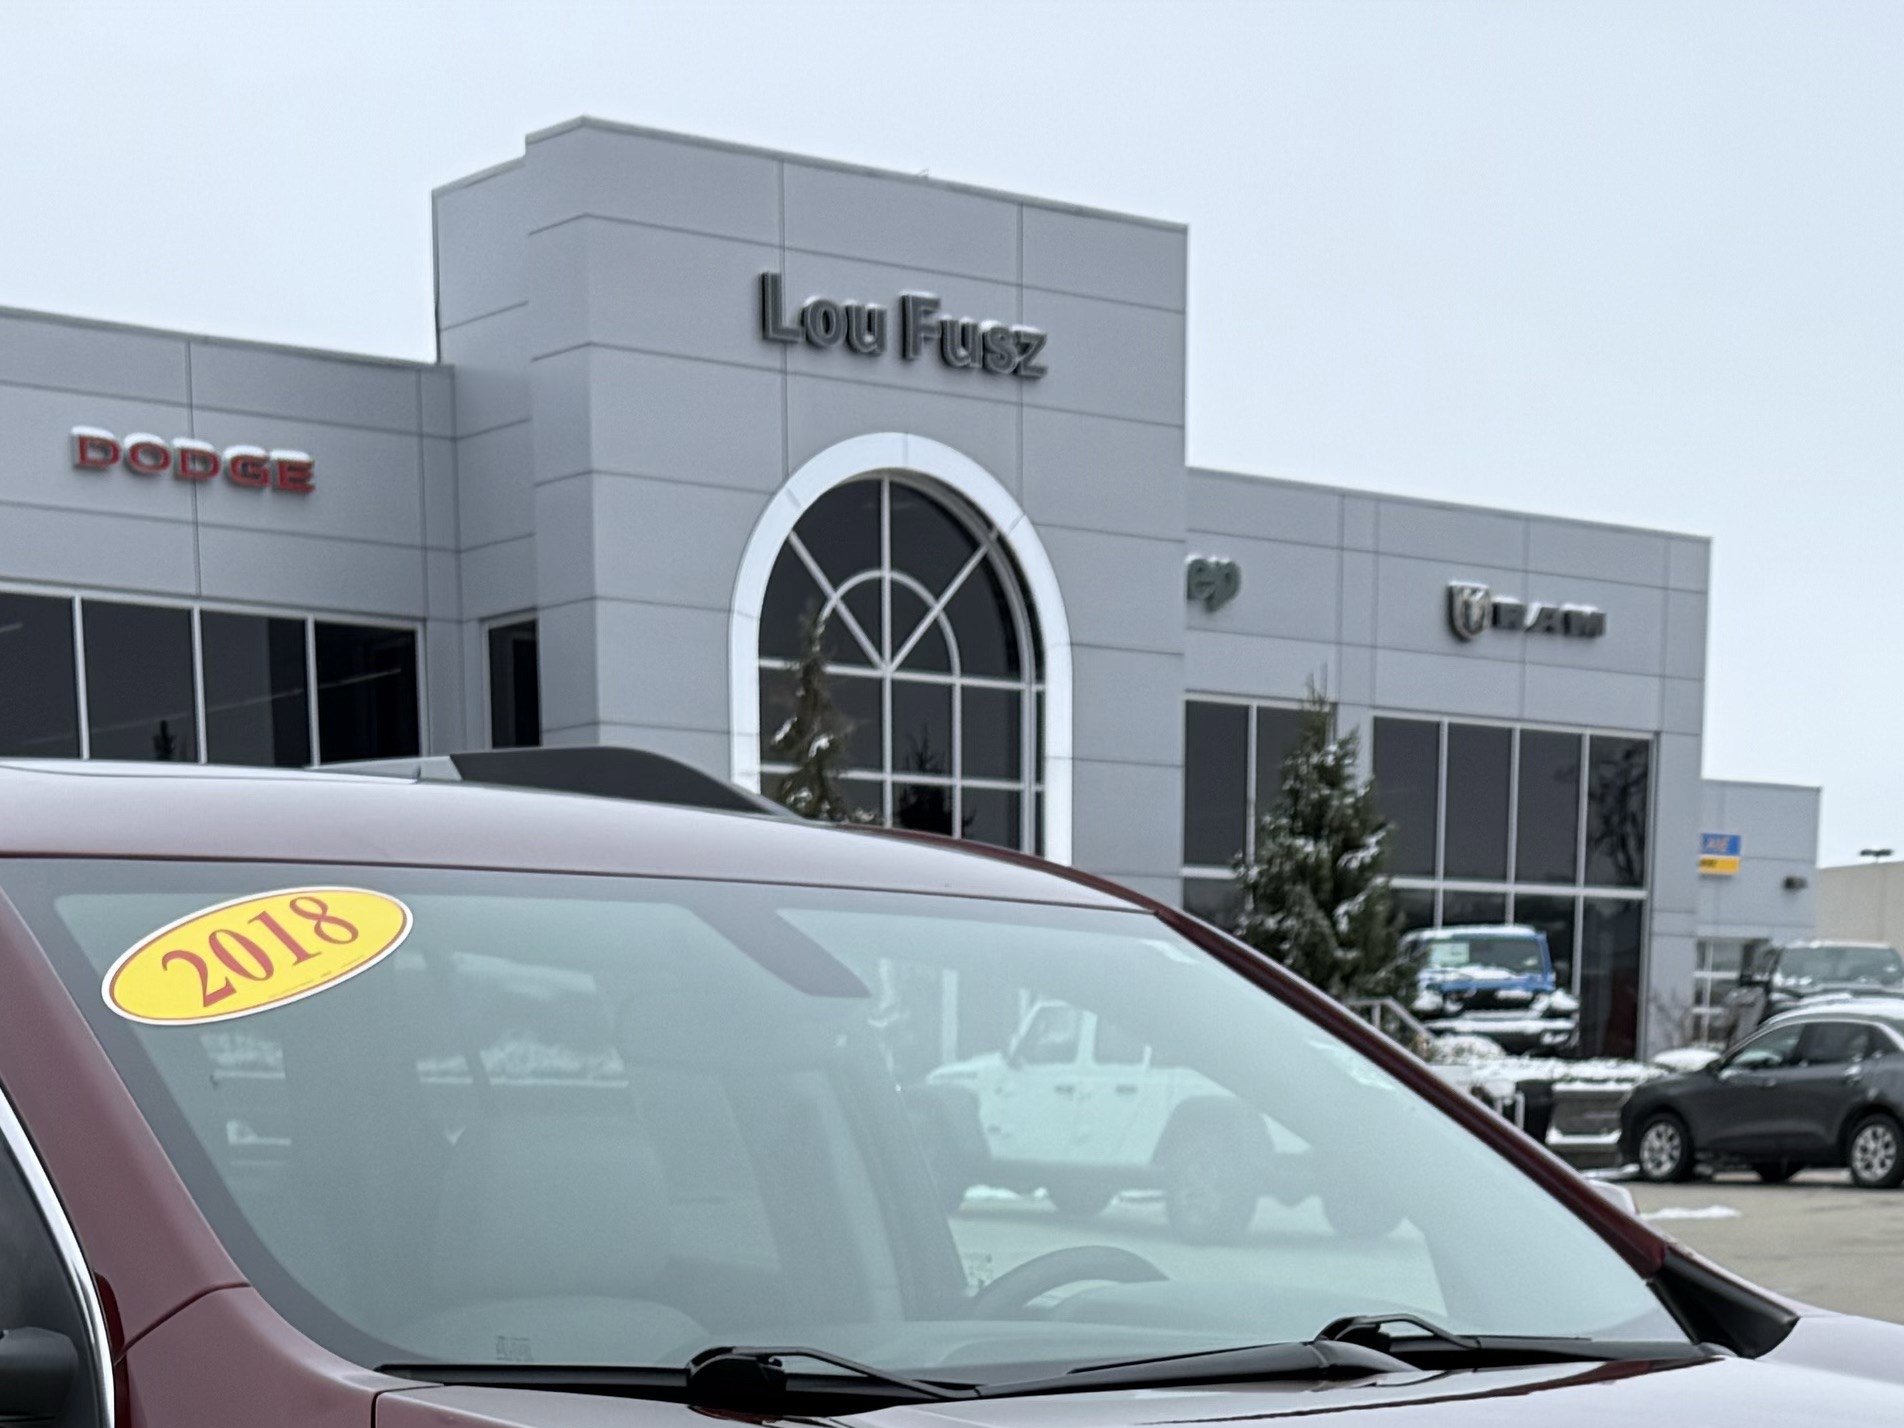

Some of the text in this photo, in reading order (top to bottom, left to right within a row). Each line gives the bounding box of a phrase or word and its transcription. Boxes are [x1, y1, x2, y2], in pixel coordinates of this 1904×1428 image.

[758, 270, 1048, 379] Lou Fusz
[70, 425, 315, 494] DODGE
[161, 896, 360, 1007] 2018
